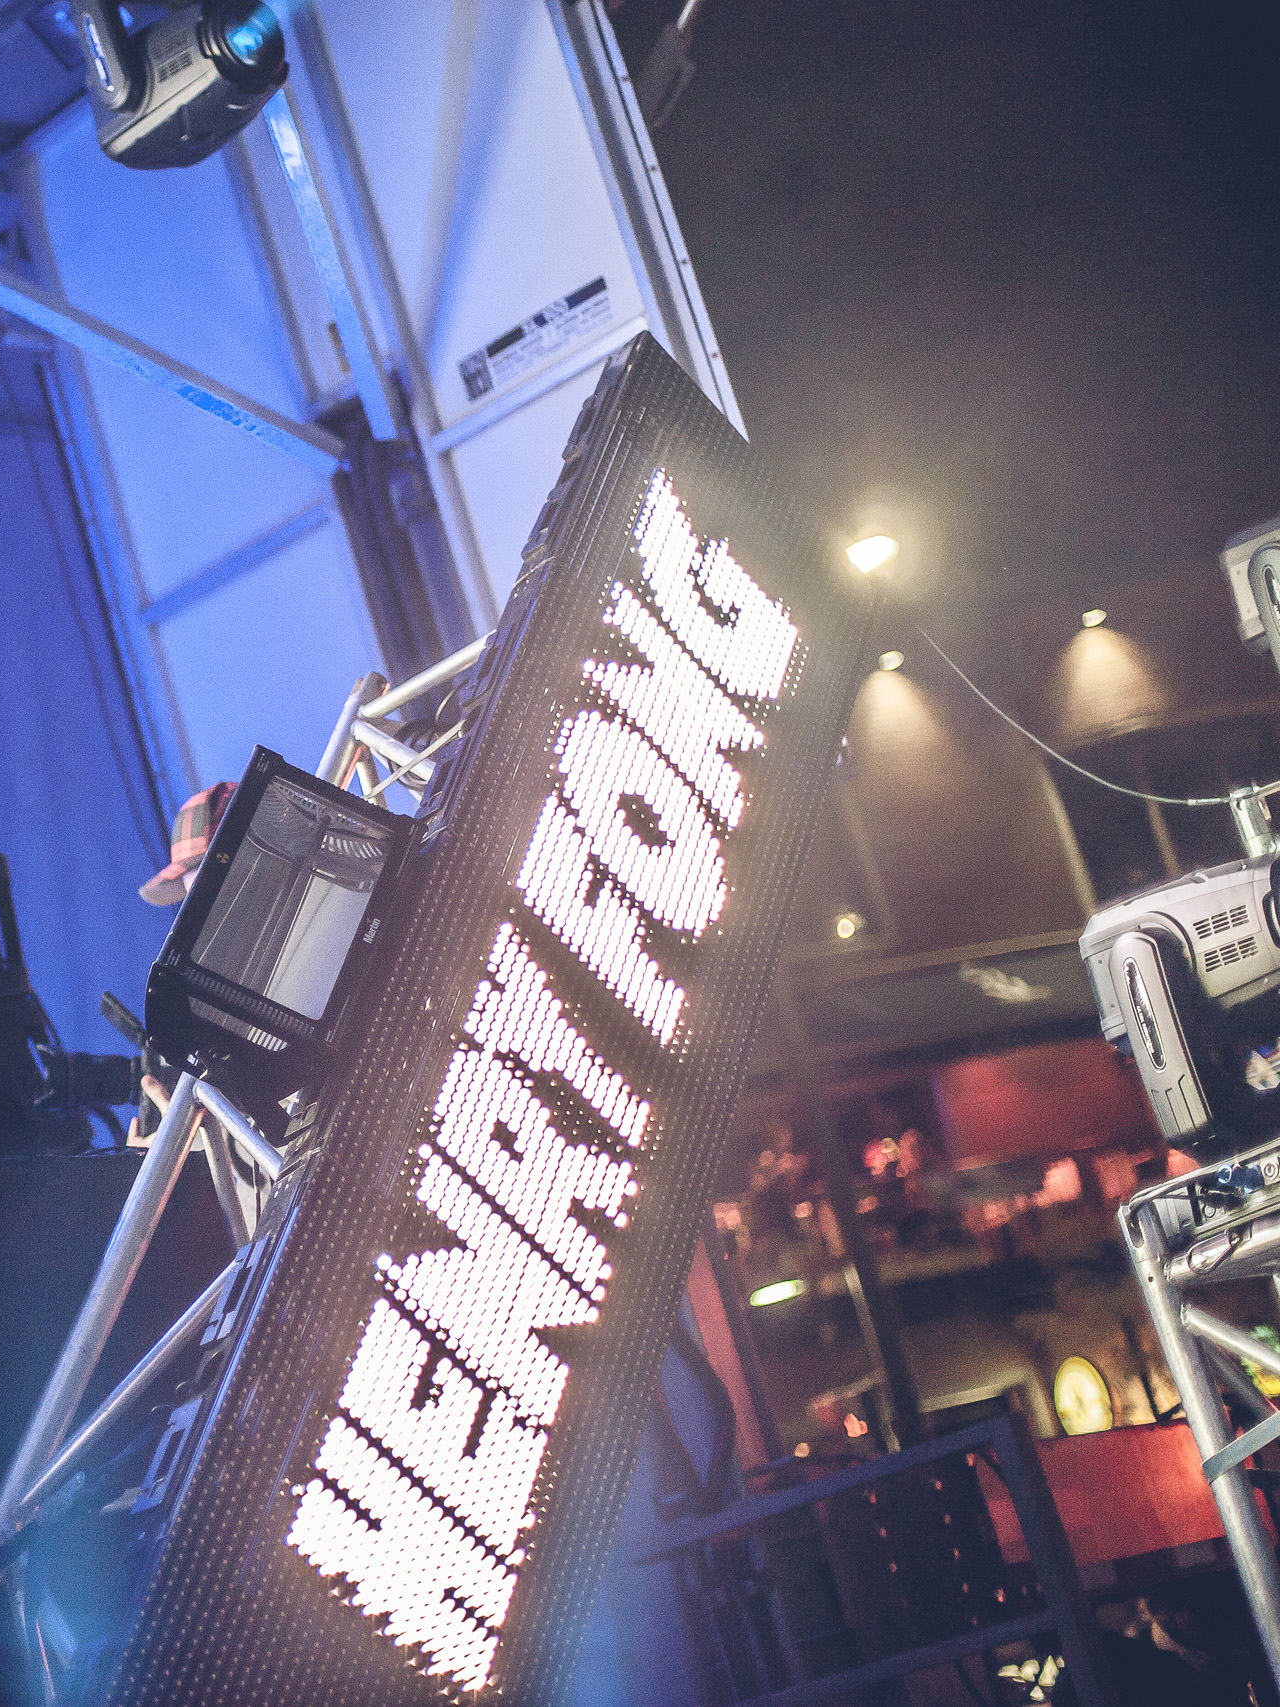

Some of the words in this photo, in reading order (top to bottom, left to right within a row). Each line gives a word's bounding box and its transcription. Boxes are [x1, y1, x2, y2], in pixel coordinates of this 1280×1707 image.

[286, 922, 650, 1692] HENRY
[518, 468, 797, 1047] FONG
[362, 917, 381, 943] Martin
